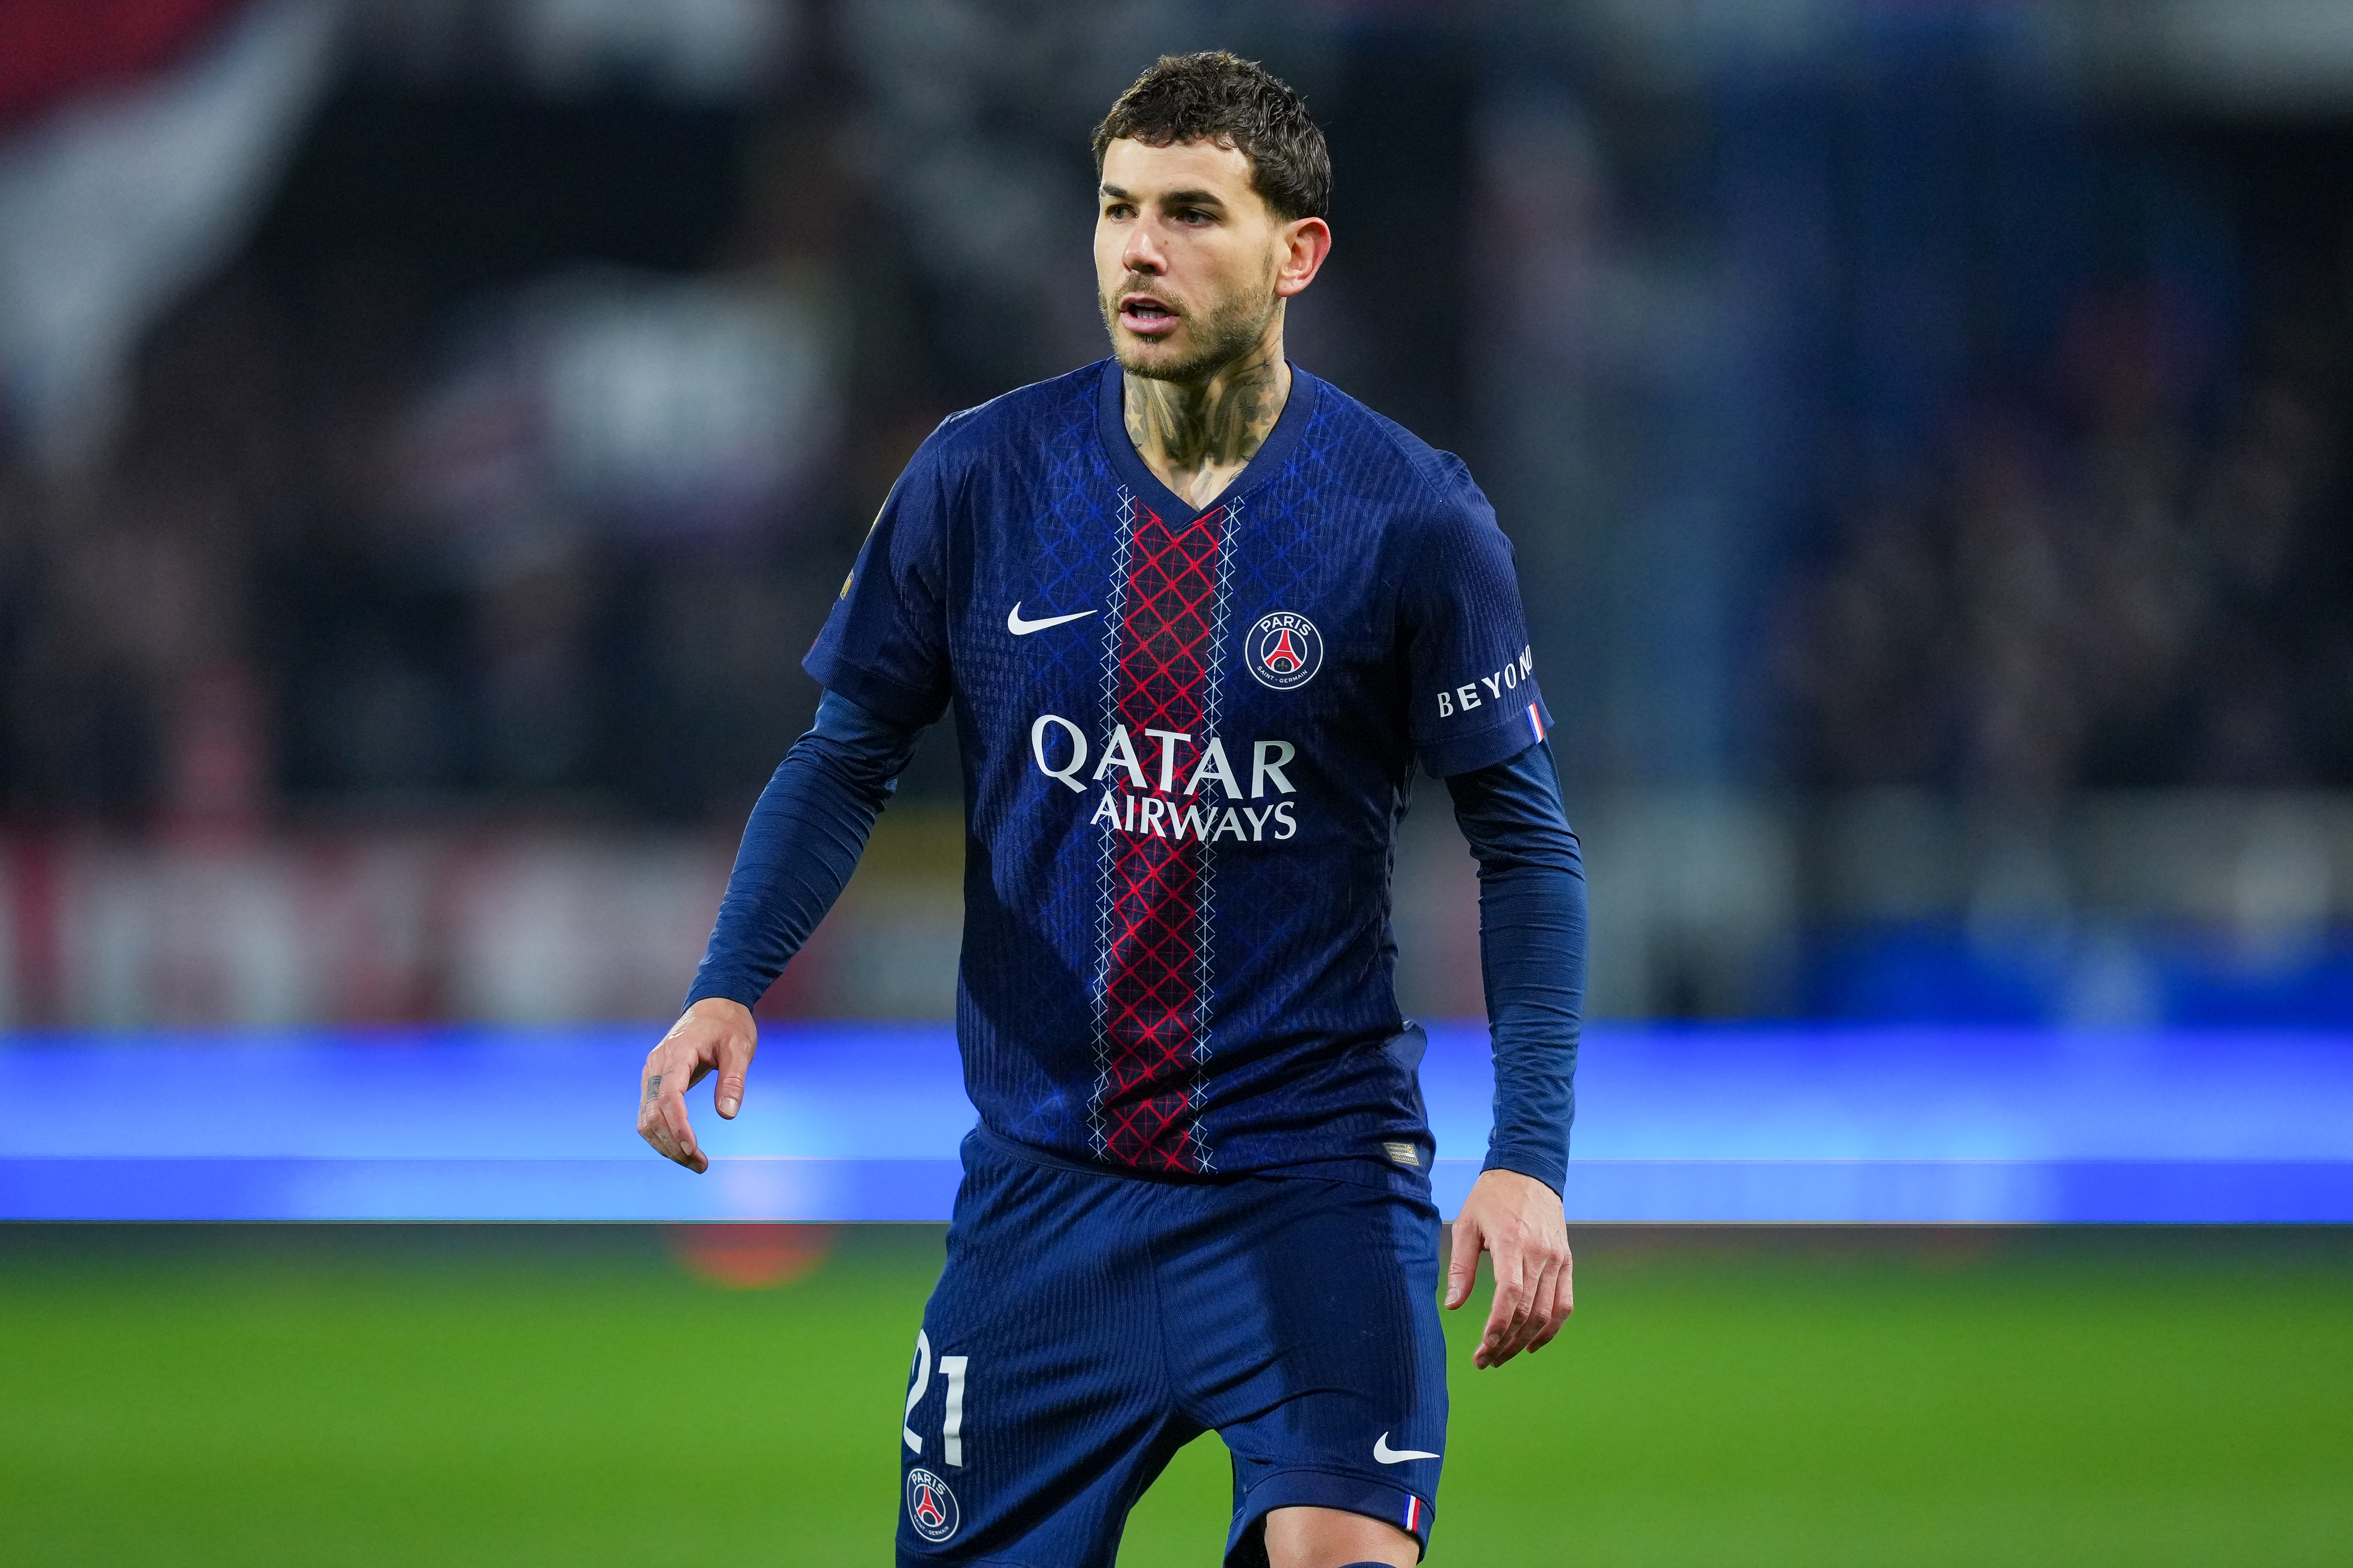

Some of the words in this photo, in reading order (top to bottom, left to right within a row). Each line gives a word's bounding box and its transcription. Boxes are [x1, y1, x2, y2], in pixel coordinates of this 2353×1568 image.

[1260, 616, 1311, 636] PARIS
[1437, 644, 1532, 718] BEYOND
[1031, 714, 1297, 799] QATAR
[1090, 790, 1297, 842] AIRWAYS
[903, 1328, 968, 1467] 21
[911, 1472, 945, 1495] PARIS
